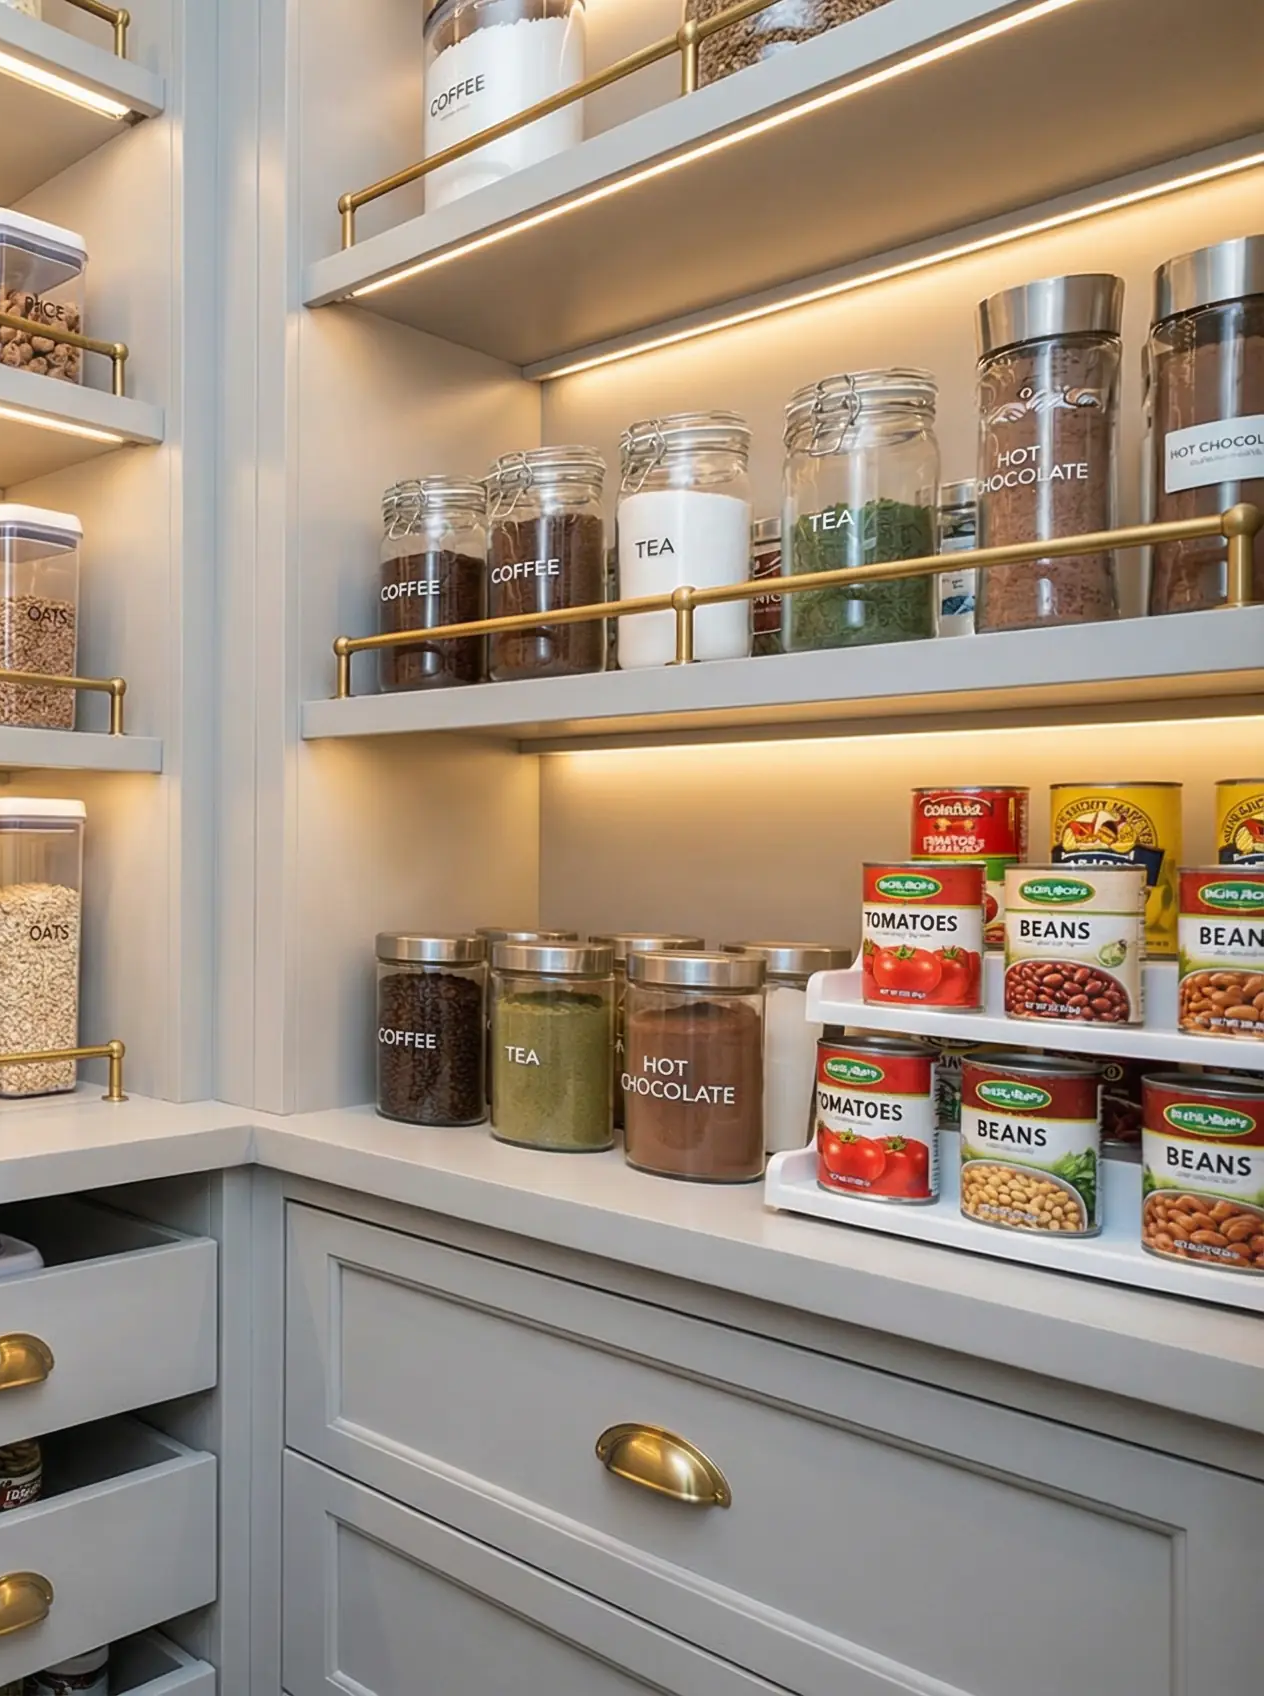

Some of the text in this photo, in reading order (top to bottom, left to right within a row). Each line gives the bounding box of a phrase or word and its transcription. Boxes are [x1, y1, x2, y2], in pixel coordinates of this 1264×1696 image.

[430, 74, 485, 117] COFFEE
[997, 445, 1041, 468] HOT
[1170, 444, 1195, 460] HOT
[809, 509, 855, 533] TEA
[635, 538, 674, 559] TEA
[491, 558, 559, 584] COFFEE
[381, 580, 440, 601] COFFEE
[28, 606, 68, 625] OATS
[29, 924, 69, 941] OATS
[864, 911, 958, 932] TOMATOES
[1020, 919, 1090, 940] BEANS
[378, 1027, 436, 1050] COFFEE
[505, 1045, 540, 1066] TEA
[643, 1055, 688, 1077] HOT
[621, 1073, 735, 1105] CHOCOLATE
[978, 1118, 1047, 1147] BEANS
[1167, 1146, 1252, 1177] BEANS
